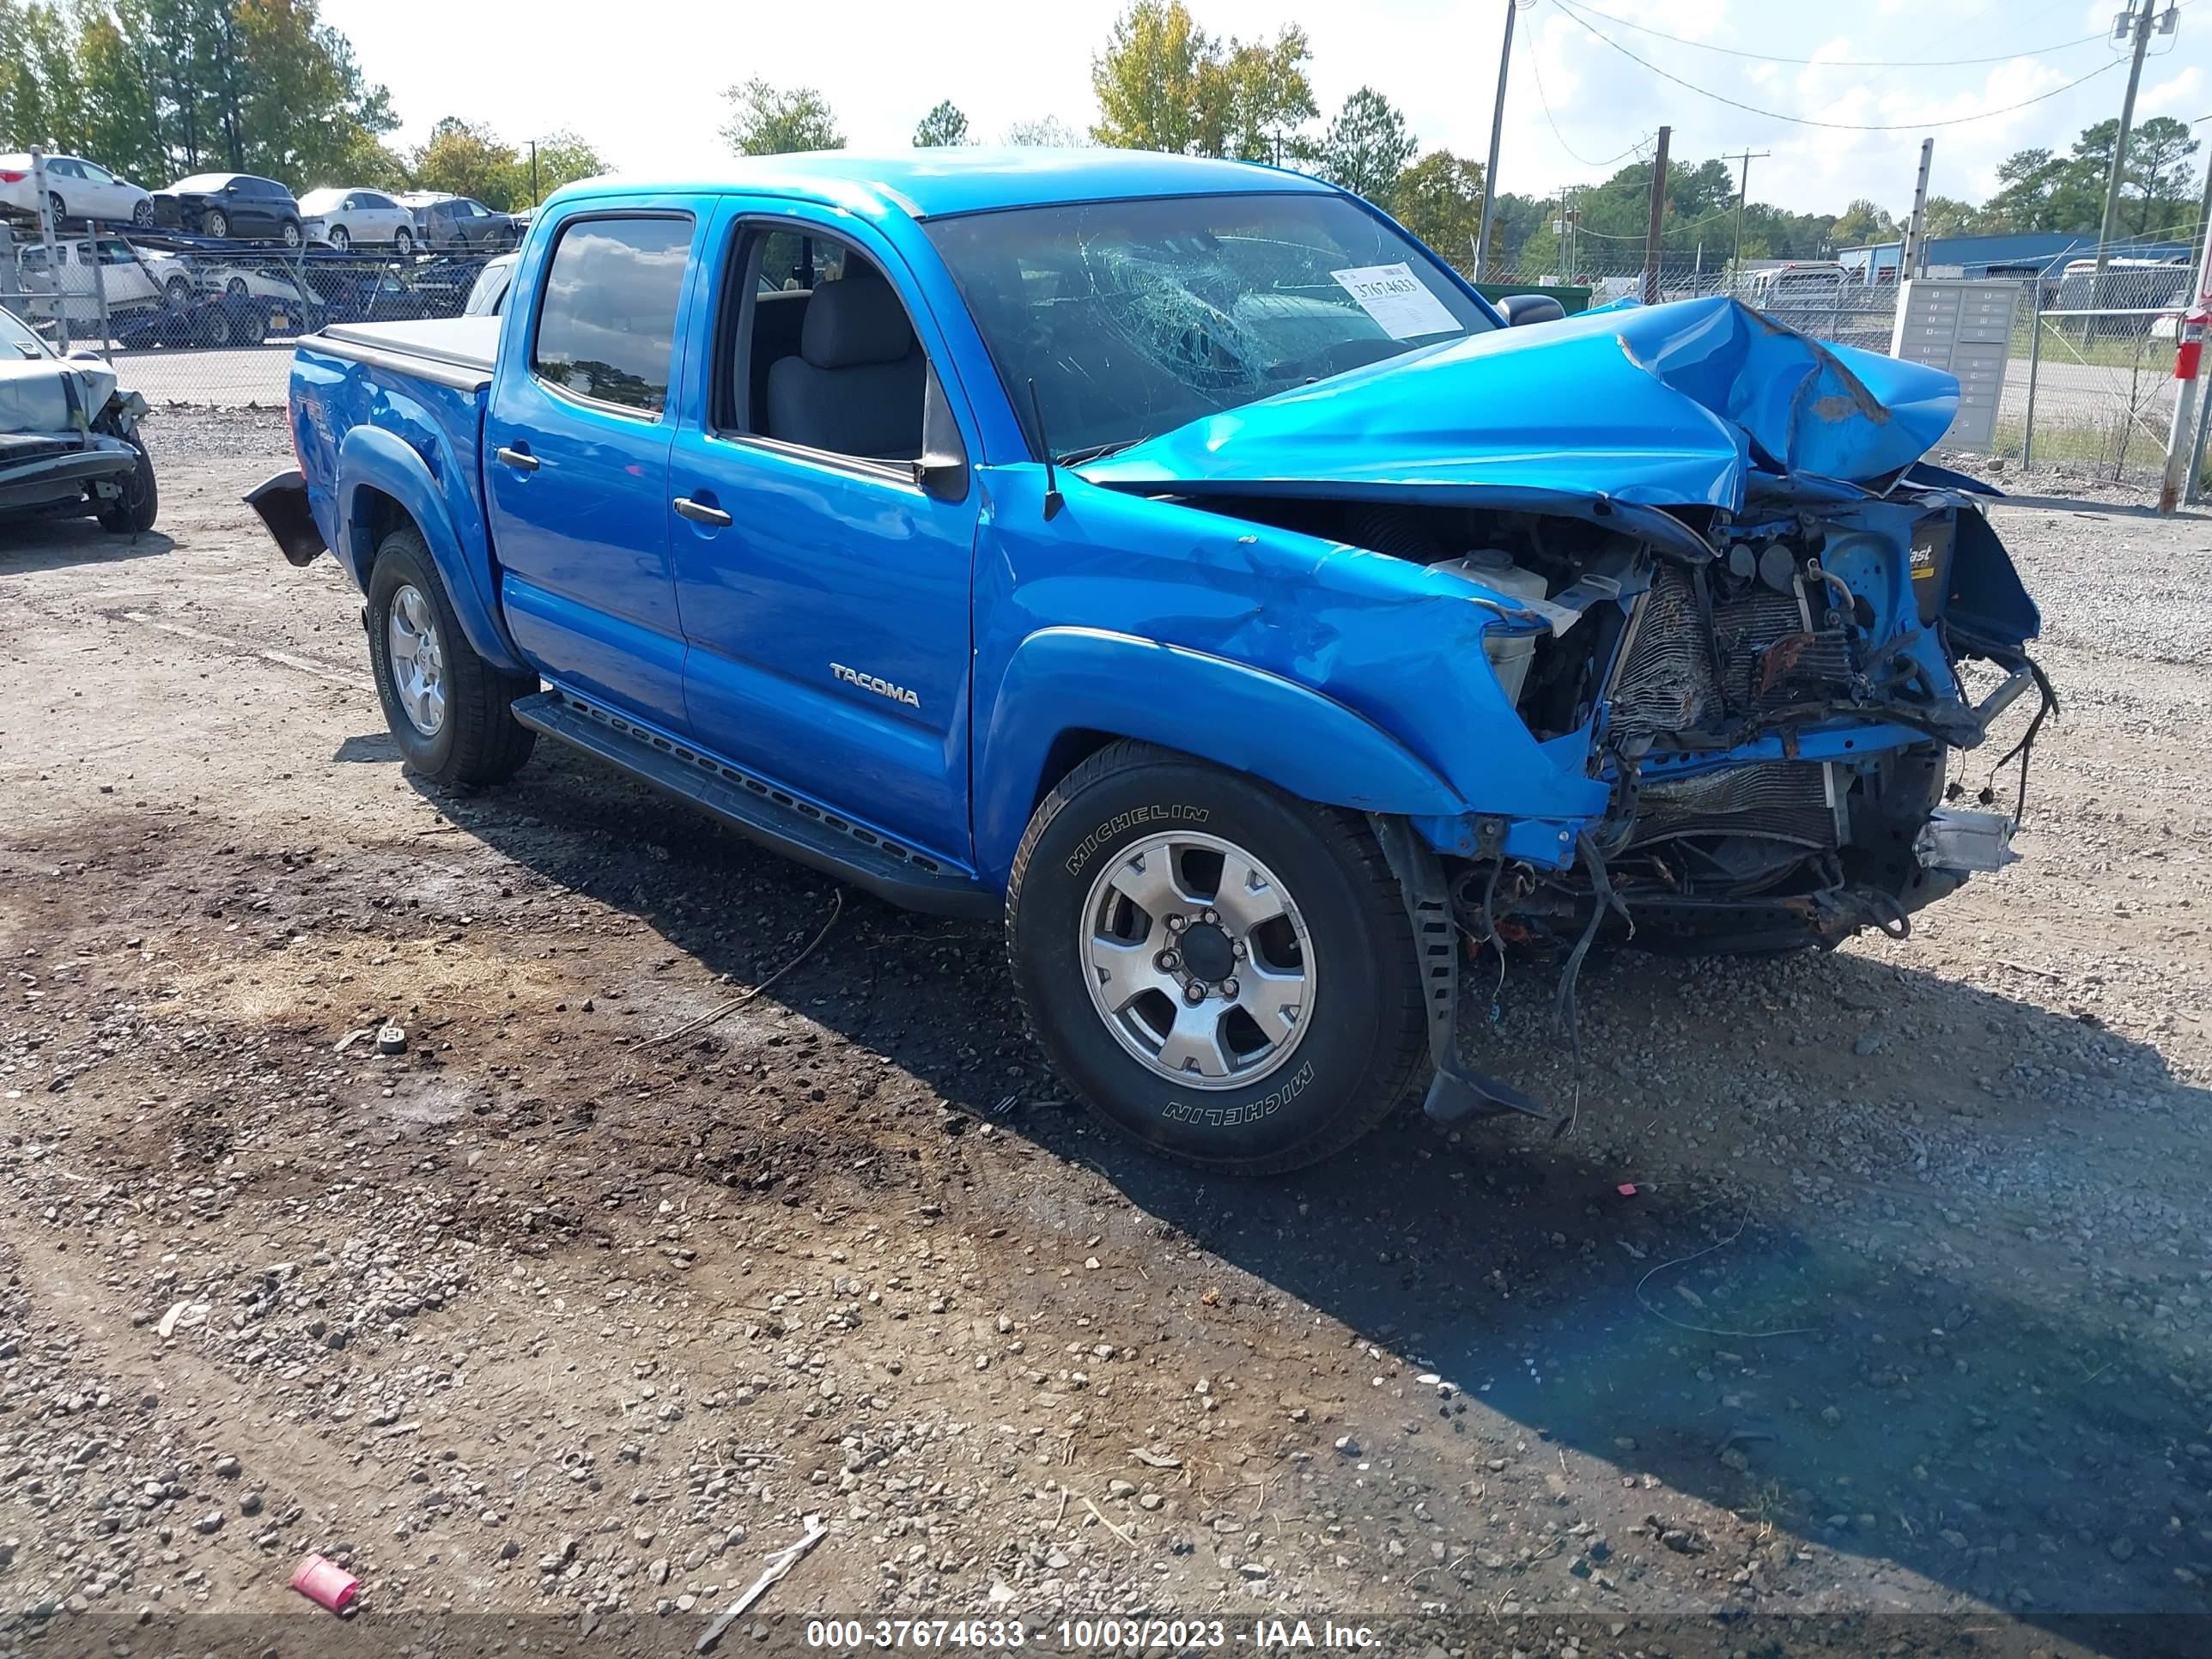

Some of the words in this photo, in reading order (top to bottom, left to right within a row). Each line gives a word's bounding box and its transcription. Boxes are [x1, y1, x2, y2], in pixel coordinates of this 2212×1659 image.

[1354, 278, 1417, 298] 37674633
[829, 662, 921, 708] TACOMA
[1065, 804, 1210, 877] MICHELIN
[1162, 1060, 1315, 1127] MICHELIN
